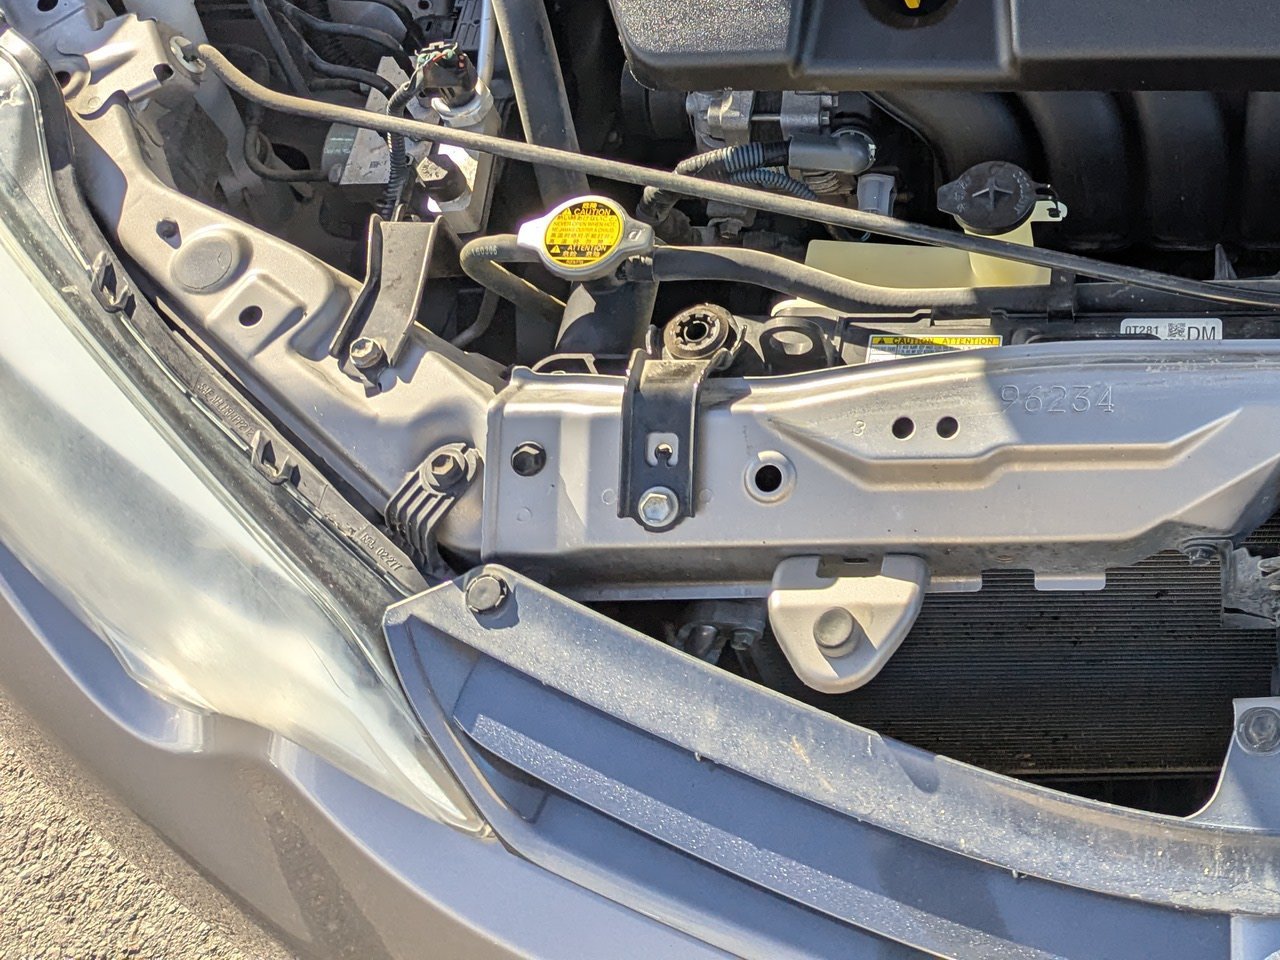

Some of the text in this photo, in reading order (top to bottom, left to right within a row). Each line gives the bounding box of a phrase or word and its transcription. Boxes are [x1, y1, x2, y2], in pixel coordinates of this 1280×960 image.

[574, 208, 611, 216] CAUTION
[1187, 326, 1216, 340] DM
[1000, 384, 1115, 413] 96234
